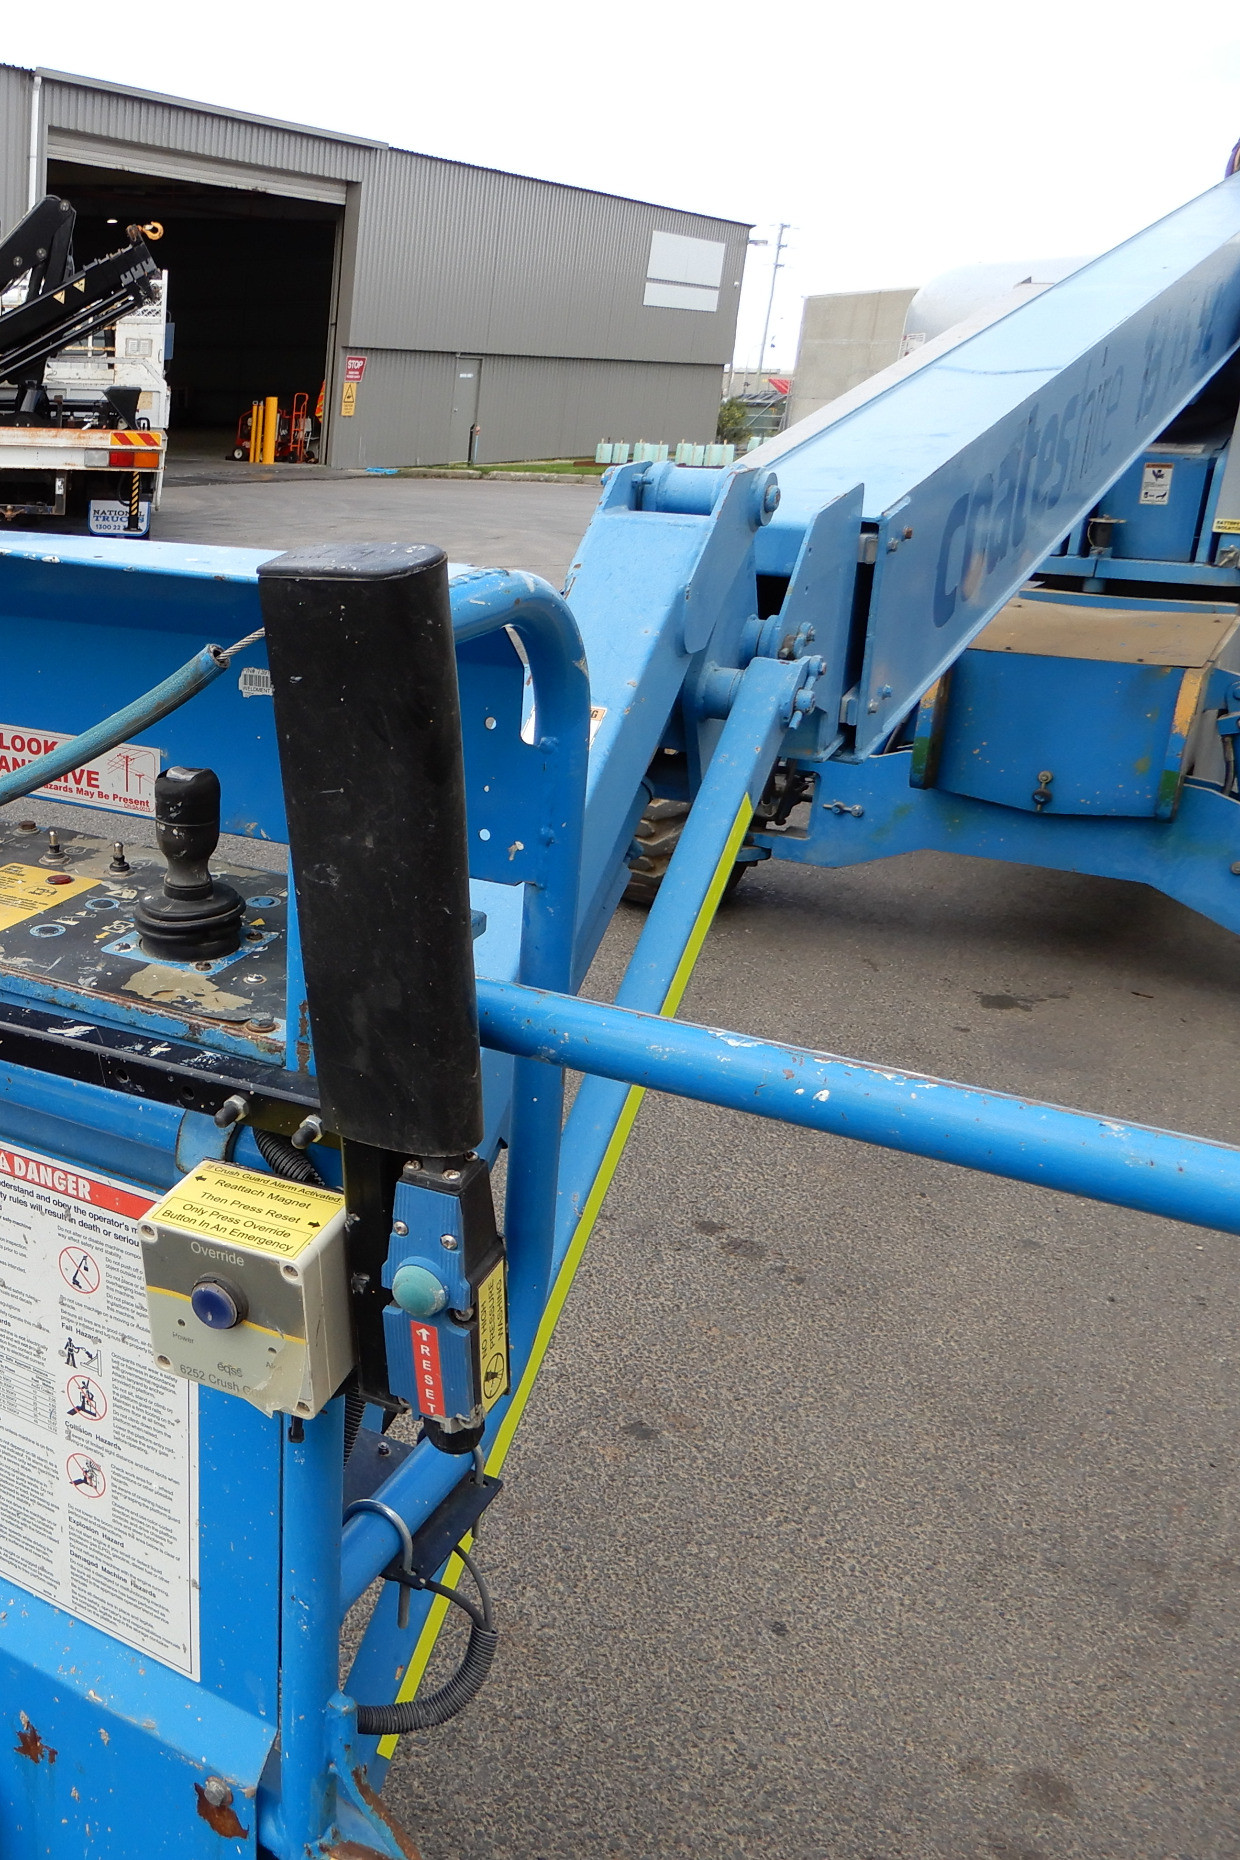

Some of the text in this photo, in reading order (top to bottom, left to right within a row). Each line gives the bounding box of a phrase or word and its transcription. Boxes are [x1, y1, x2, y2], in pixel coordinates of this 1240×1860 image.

[348, 360, 364, 370] STOP
[43, 782, 73, 794] azards
[76, 786, 95, 798] May
[97, 790, 110, 800] Be
[112, 794, 150, 808] Present
[13, 1155, 91, 1200] DANGER
[214, 1166, 240, 1176] Crush
[242, 1173, 270, 1185] Guard
[272, 1180, 297, 1191] Alarm
[298, 1187, 344, 1204] Activated:
[35, 1190, 50, 1203] and
[52, 1197, 71, 1213] obey
[73, 1204, 85, 1216] the
[91, 1211, 129, 1233] operator's
[201, 1192, 301, 1224] Then Press Reset
[215, 1180, 312, 1210] Reattach Magnet
[8, 1193, 27, 1207] rules
[29, 1201, 42, 1212] will
[78, 1218, 100, 1233] death
[102, 1227, 111, 1237] or
[114, 1231, 139, 1247] seriou
[162, 1210, 294, 1252] Button In An Emergency
[182, 1204, 291, 1238] Only Press Override
[190, 1242, 244, 1266] Override
[488, 1278, 496, 1350] PRESSURE
[496, 1278, 504, 1341] WASHING
[61, 1322, 72, 1332] Fall
[172, 1331, 194, 1344] Power
[481, 1339, 488, 1360] NO
[180, 1364, 206, 1380] 6252
[209, 1374, 240, 1392] Crush
[420, 1344, 436, 1414] RESET
[64, 1419, 121, 1451] Collision Hazards
[68, 1515, 124, 1548] Explosion Hazard
[69, 1549, 155, 1598] Damaged Machine Hazards
